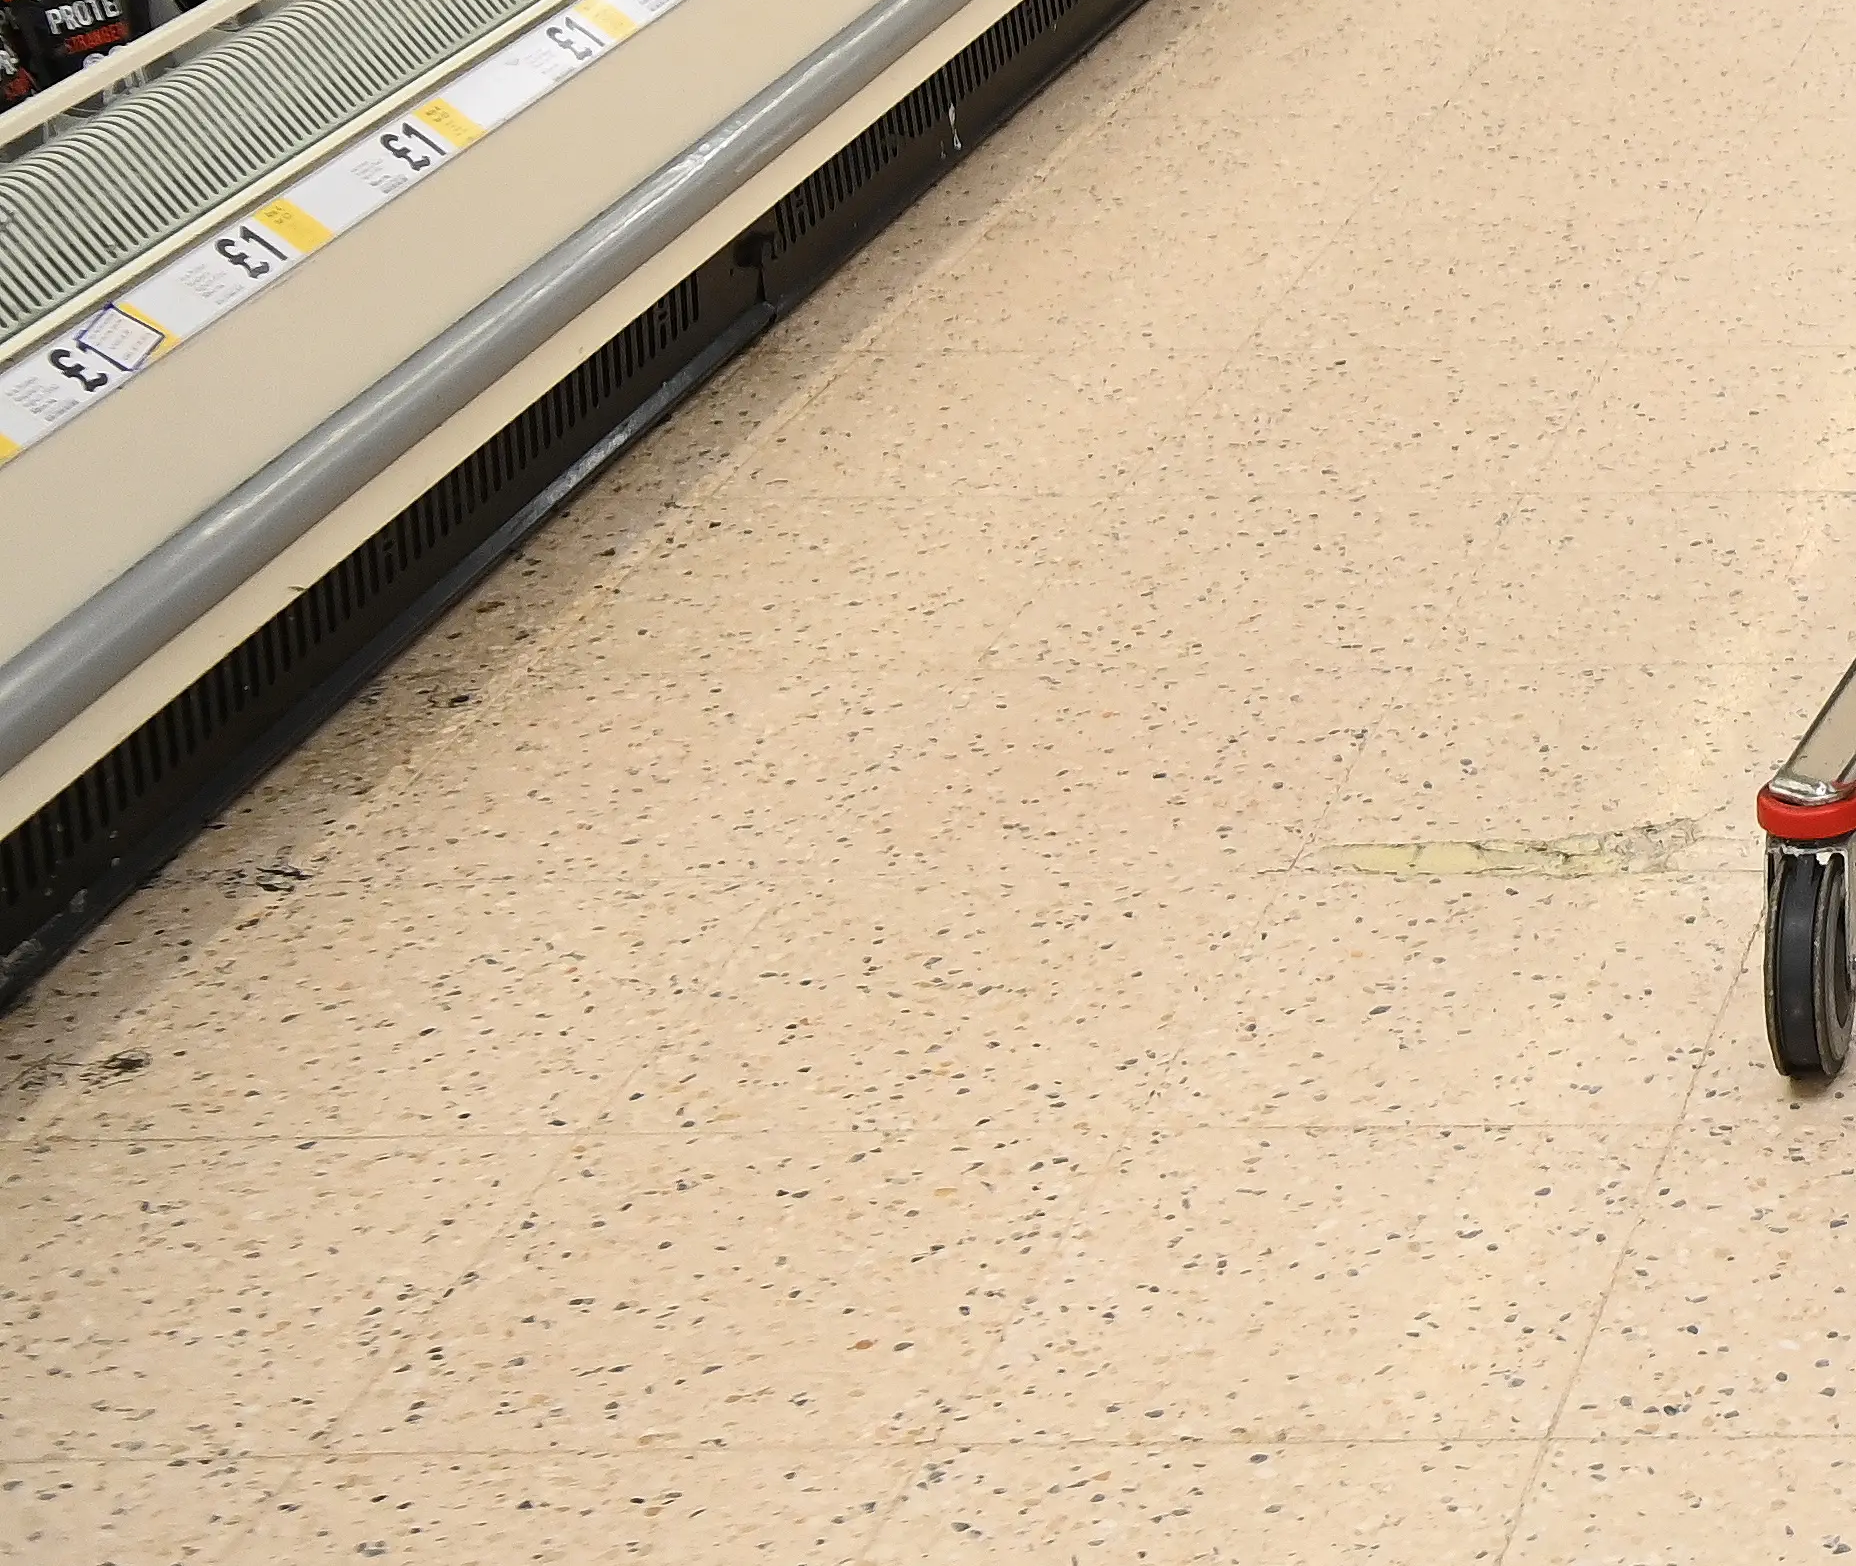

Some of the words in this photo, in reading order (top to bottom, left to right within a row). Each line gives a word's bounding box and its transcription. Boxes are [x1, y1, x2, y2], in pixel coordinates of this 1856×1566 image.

[544, 15, 605, 62] £1
[380, 121, 447, 172] £1
[213, 225, 288, 280] £1
[48, 340, 134, 393] £1
